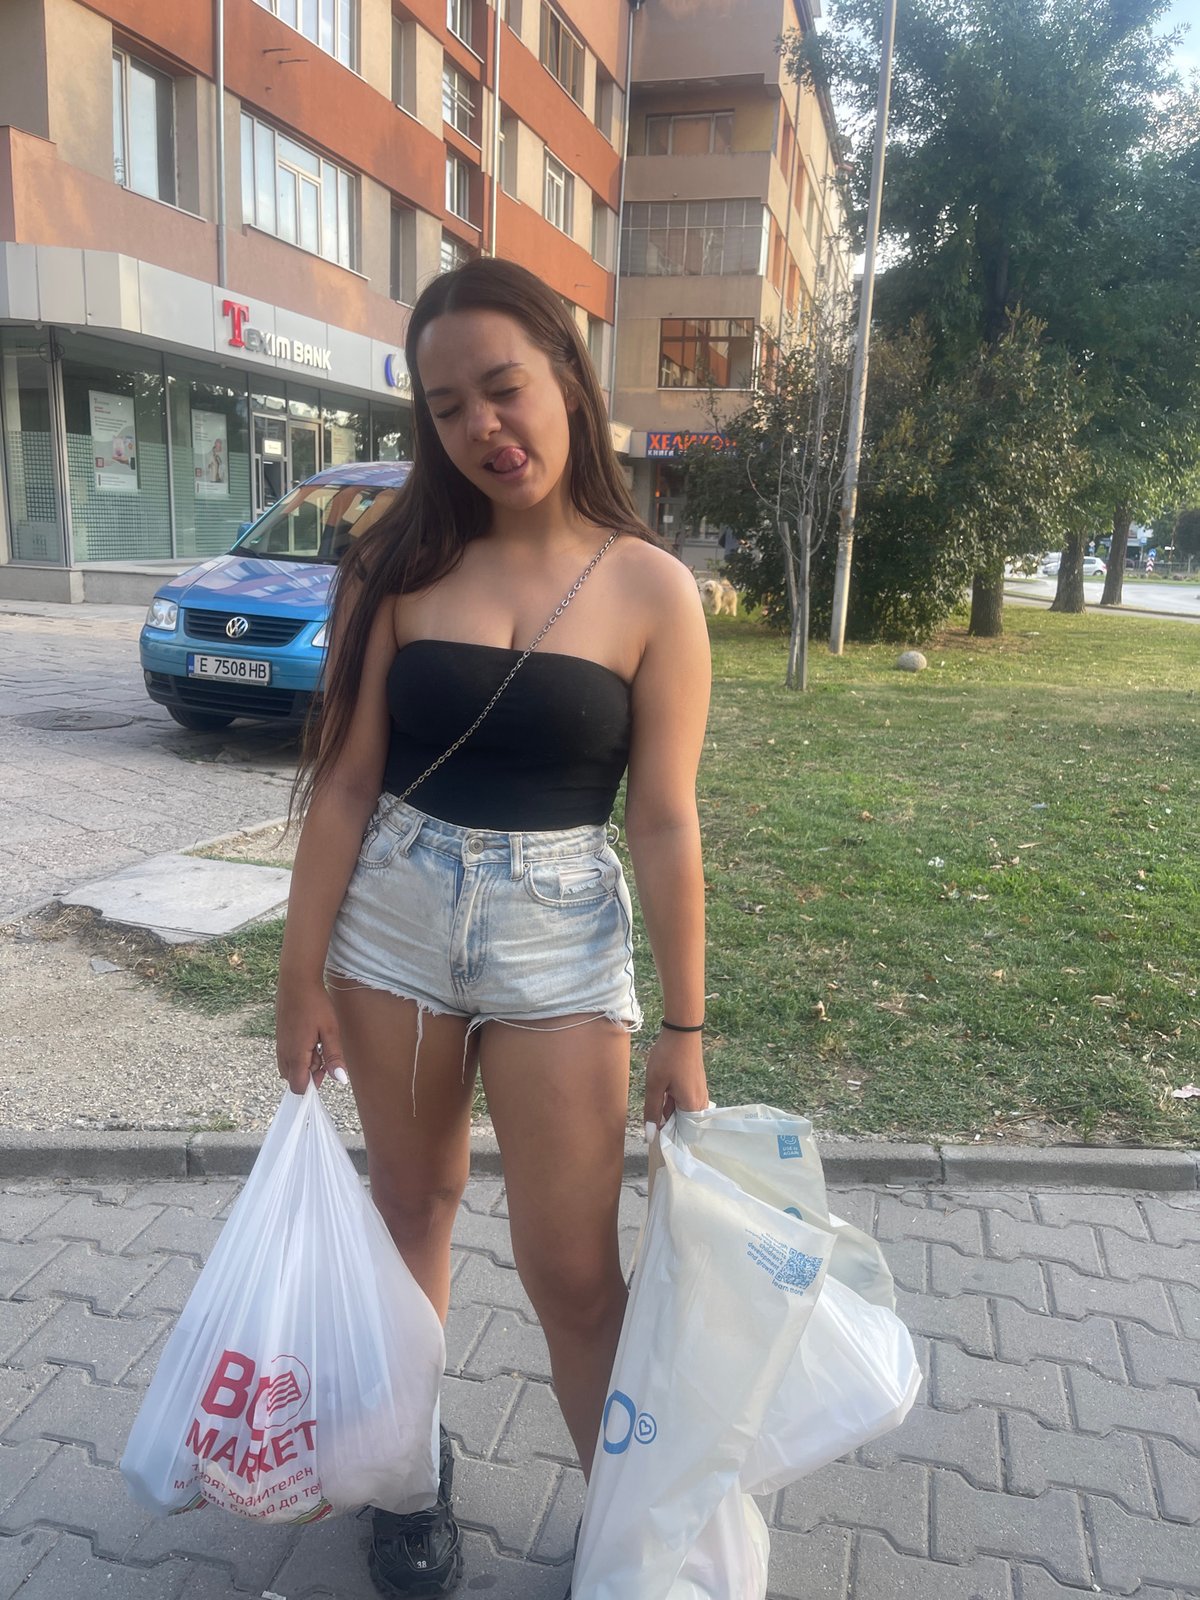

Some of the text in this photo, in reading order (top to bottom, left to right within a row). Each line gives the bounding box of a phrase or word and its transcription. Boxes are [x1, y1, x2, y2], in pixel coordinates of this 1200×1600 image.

[293, 340, 332, 370] BANK
[200, 657, 267, 679] E 7508 HB
[747, 1242, 780, 1270] development
[747, 1250, 775, 1275] and growth
[185, 1417, 317, 1484] MARKET
[228, 1467, 313, 1507] хранителен
[279, 1495, 298, 1510] до
